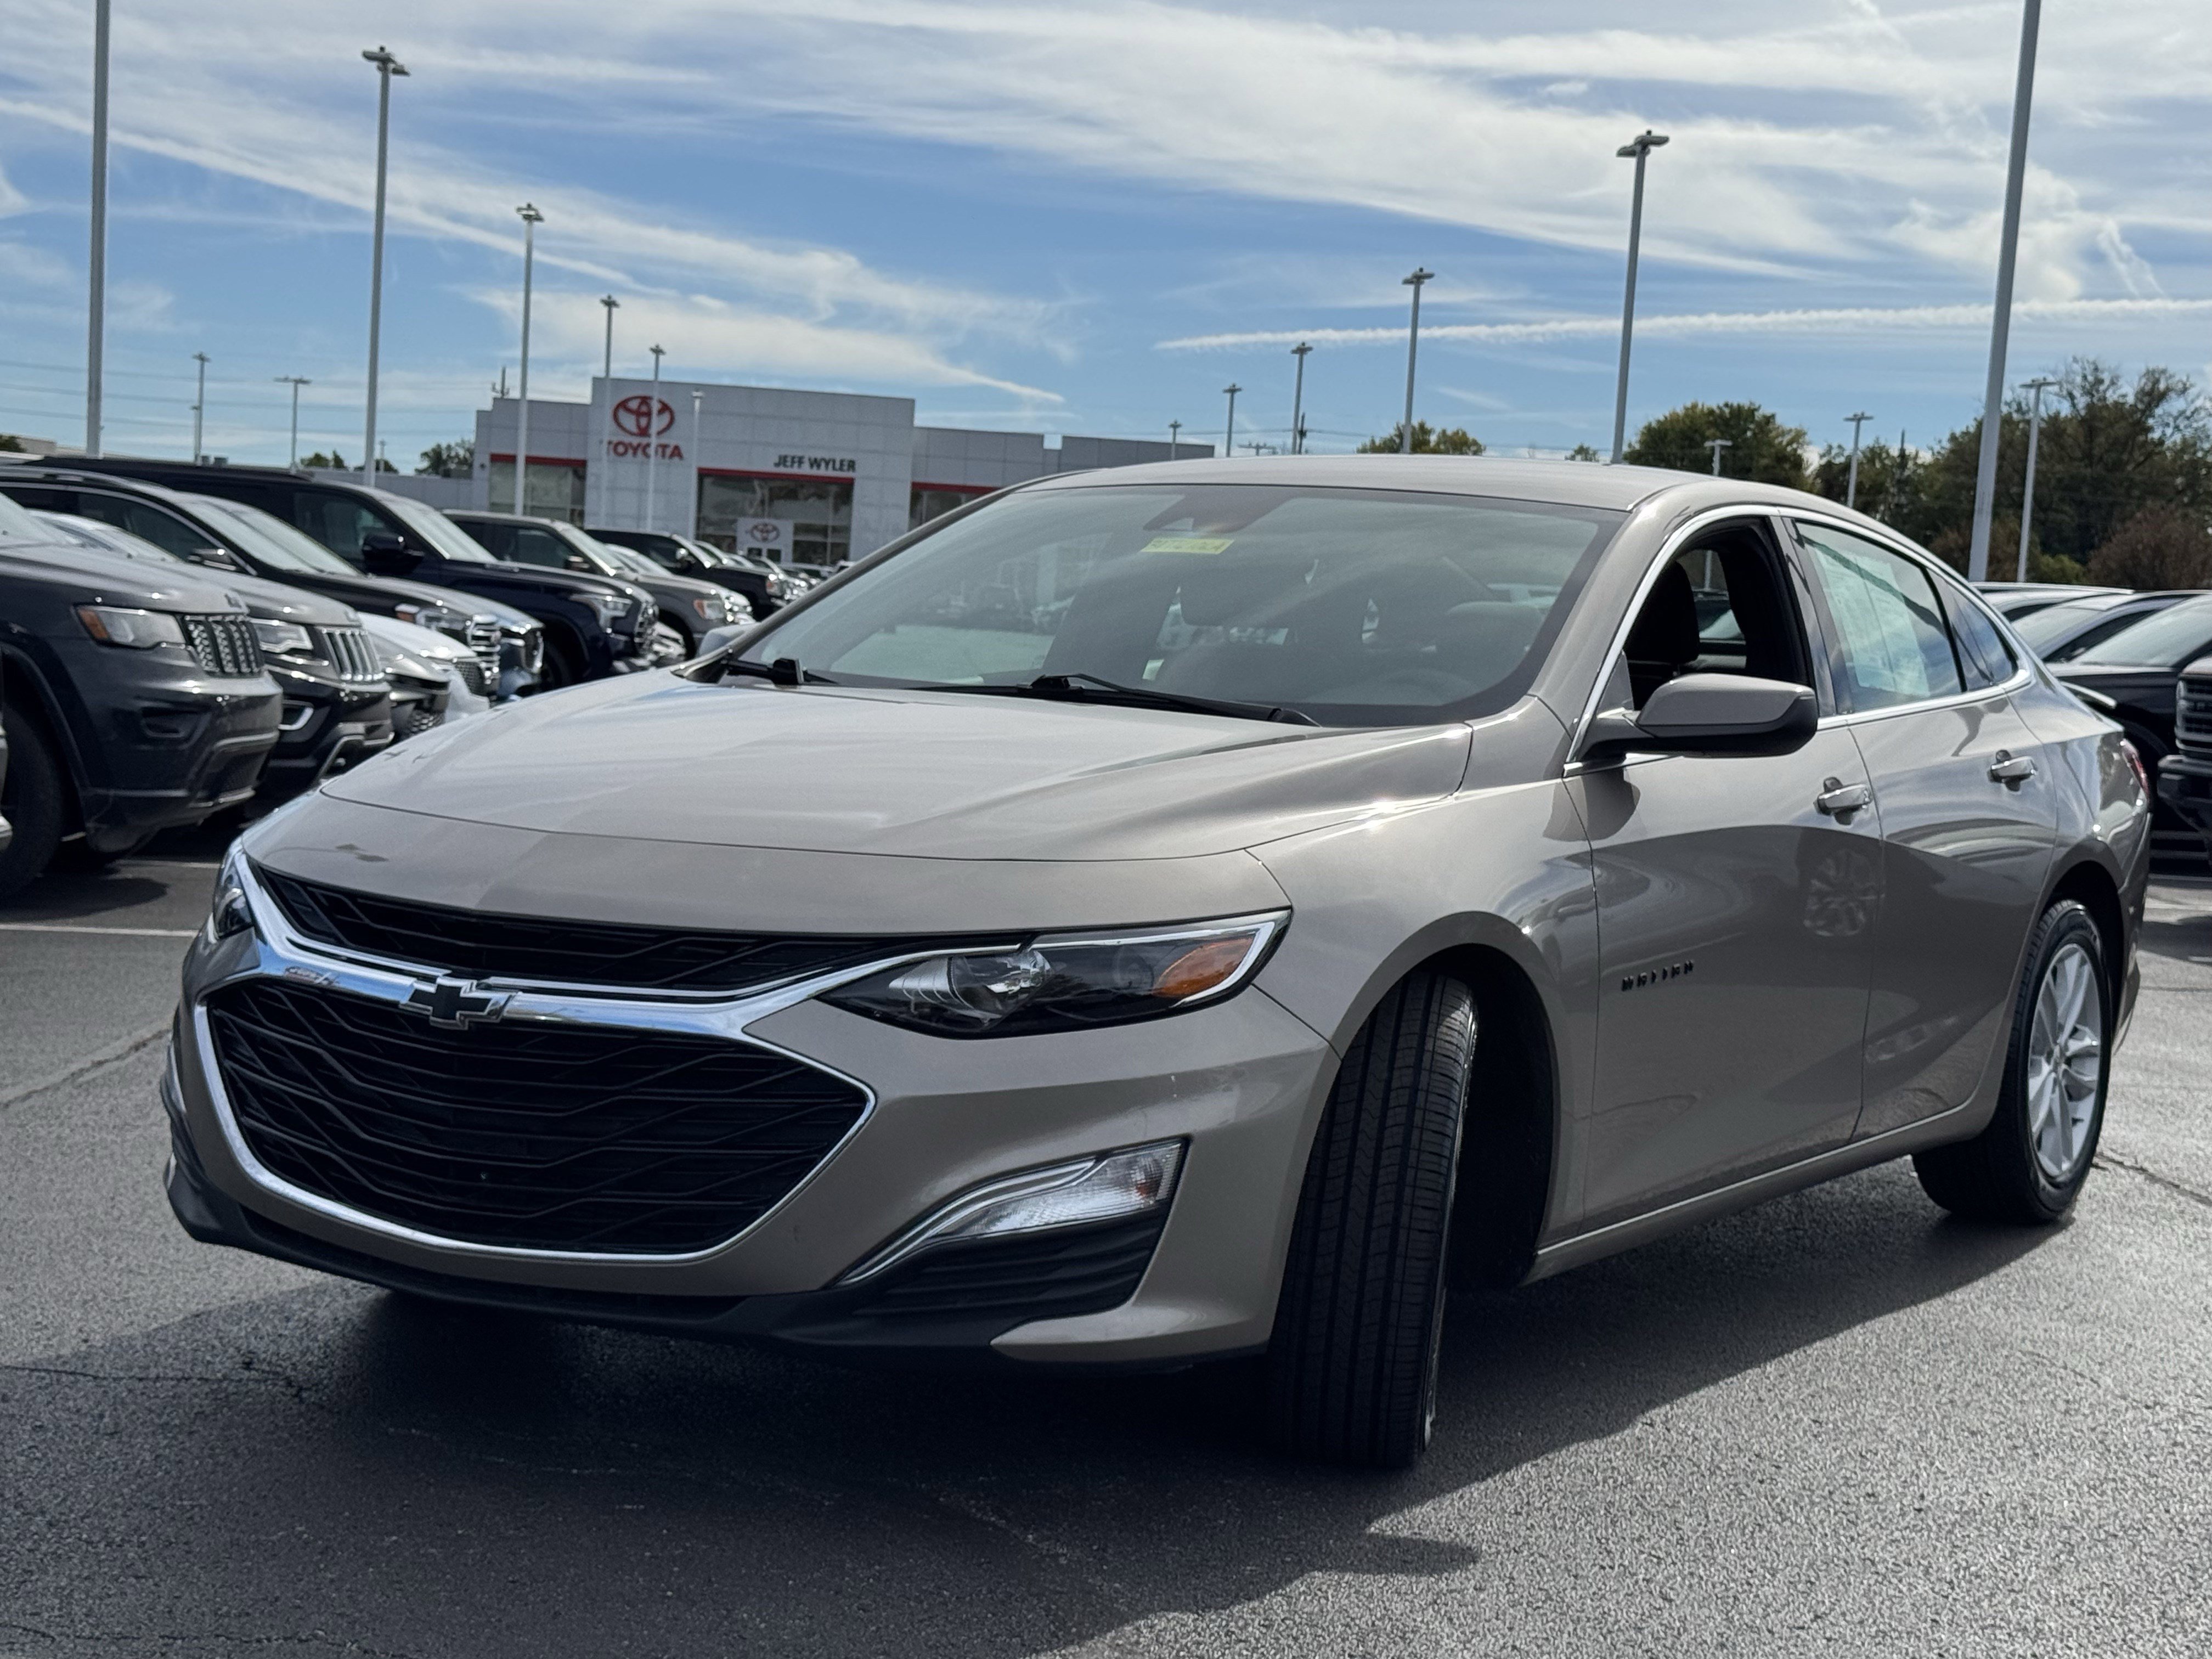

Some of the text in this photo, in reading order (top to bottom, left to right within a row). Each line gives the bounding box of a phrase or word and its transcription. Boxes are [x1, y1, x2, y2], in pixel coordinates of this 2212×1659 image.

[600, 439, 684, 460] TOYOTA
[773, 454, 856, 472] JEFF WYLER
